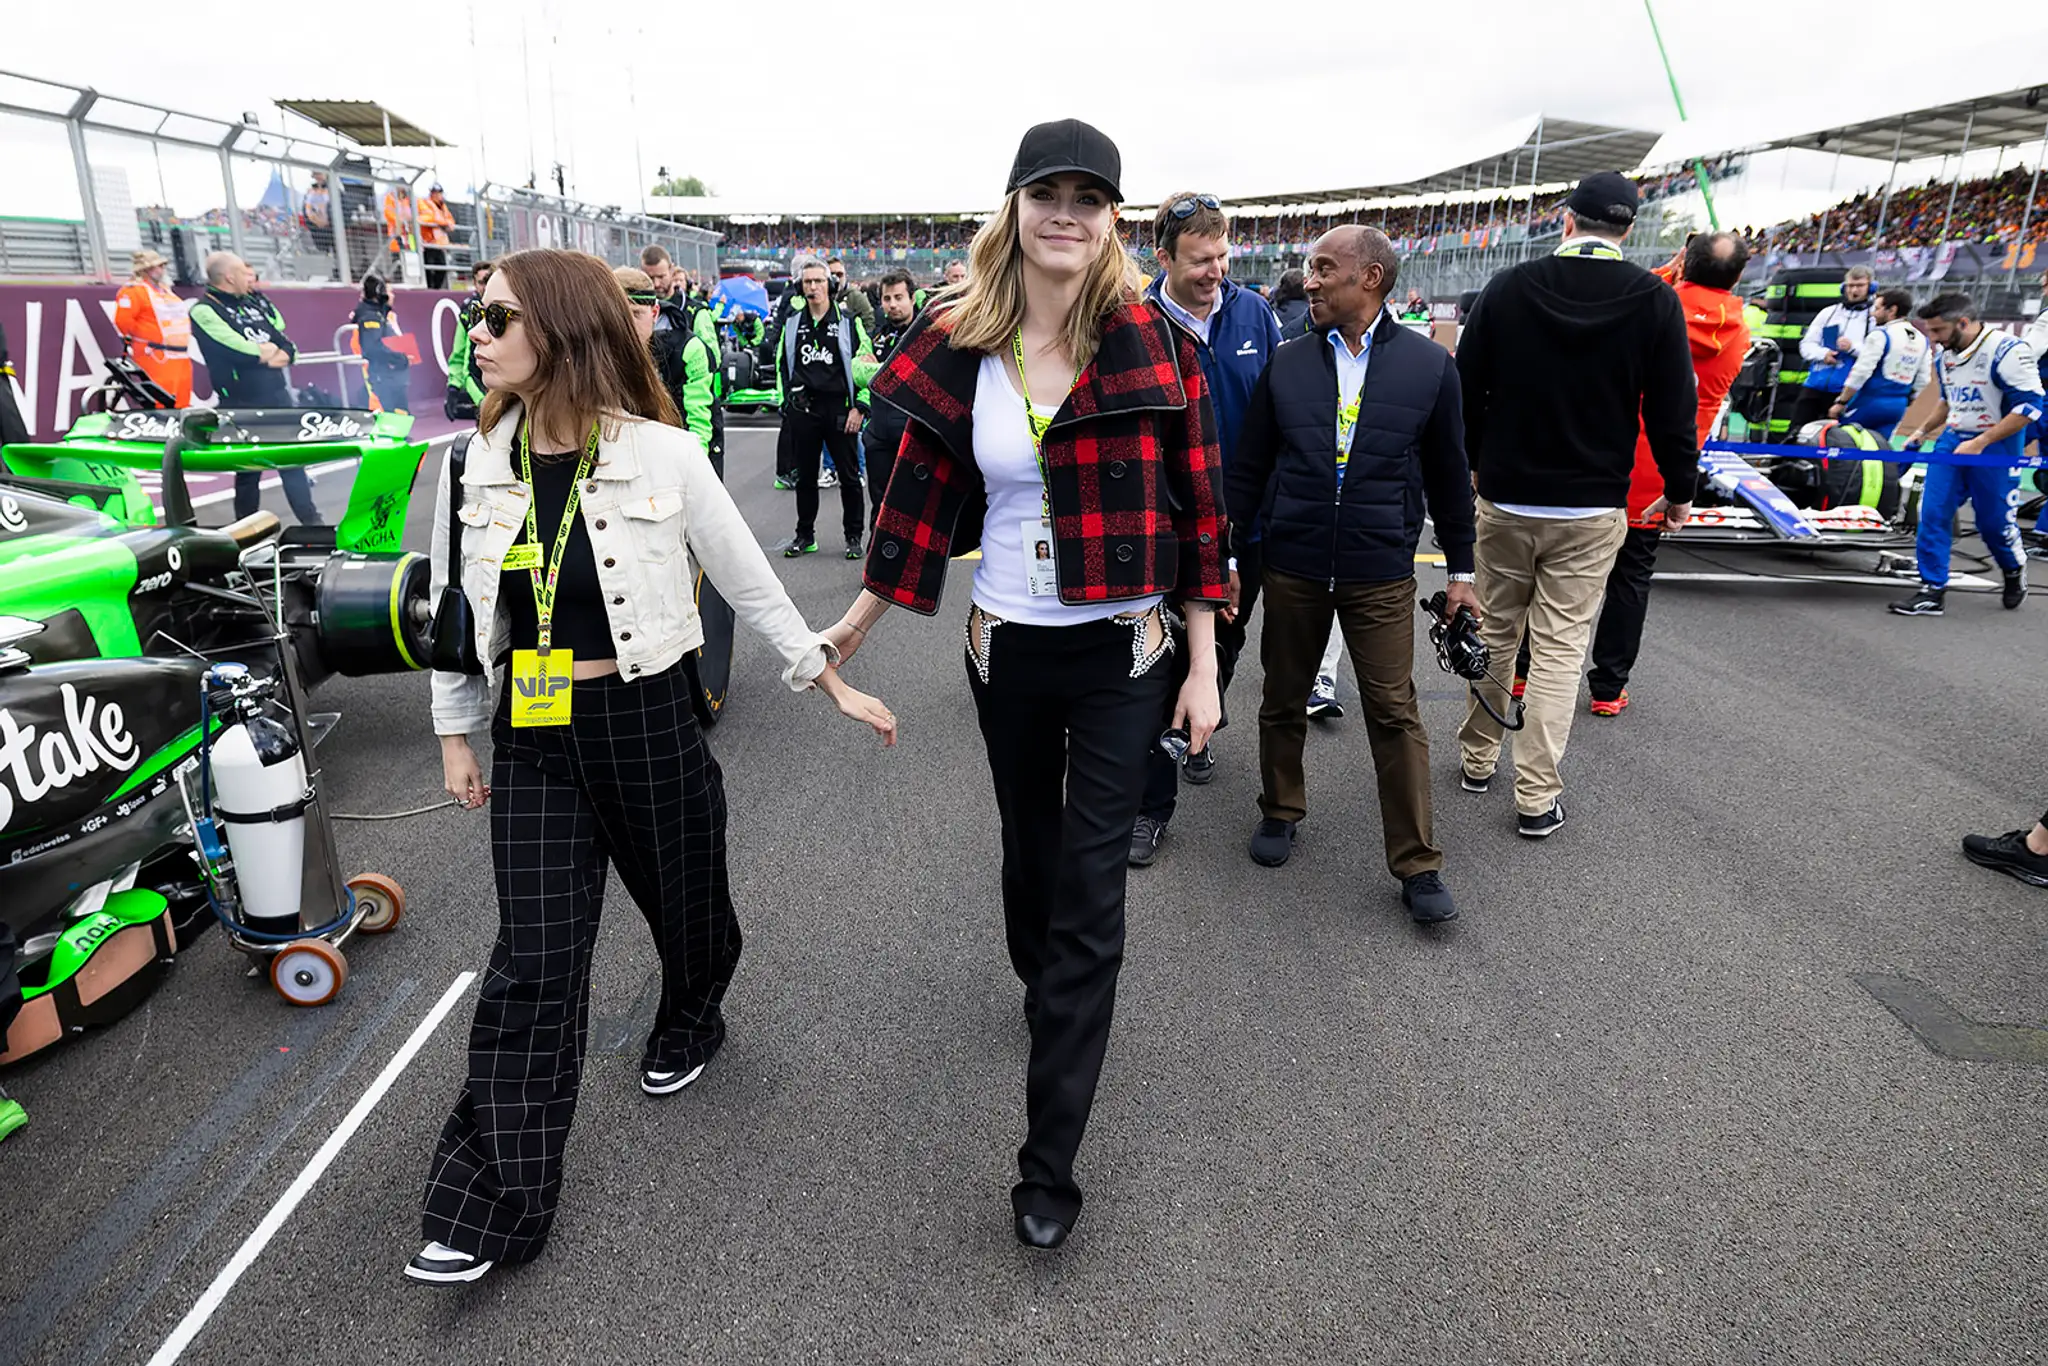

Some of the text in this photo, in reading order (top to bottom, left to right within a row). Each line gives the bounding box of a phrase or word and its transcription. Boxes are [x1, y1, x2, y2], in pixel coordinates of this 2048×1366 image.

[801, 344, 834, 365] Stake
[1949, 386, 1984, 402] VISA
[559, 523, 568, 538] VIP
[135, 571, 172, 595] zero
[514, 676, 570, 697] VIP
[22, 832, 71, 858] edelweiss
